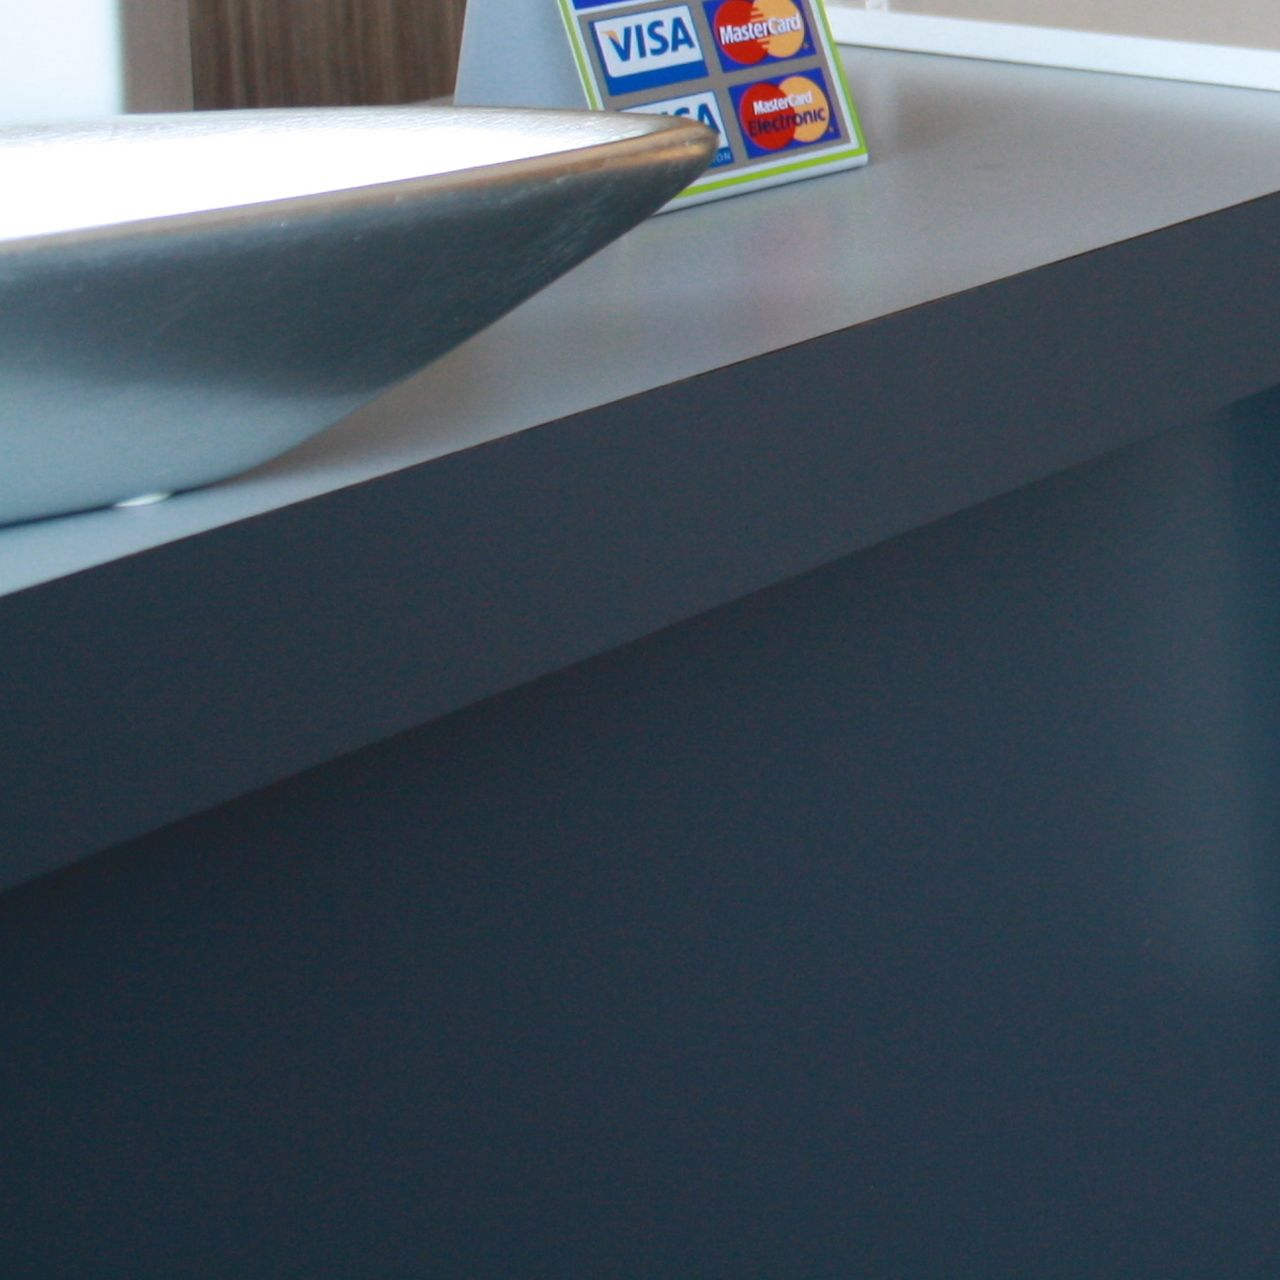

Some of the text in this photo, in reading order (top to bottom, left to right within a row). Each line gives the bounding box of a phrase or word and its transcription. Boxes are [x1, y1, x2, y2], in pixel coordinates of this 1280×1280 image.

[602, 16, 695, 62] VISA
[719, 13, 802, 45] MasterCard
[753, 90, 813, 115] MasterCard
[748, 108, 826, 138] Electronic
